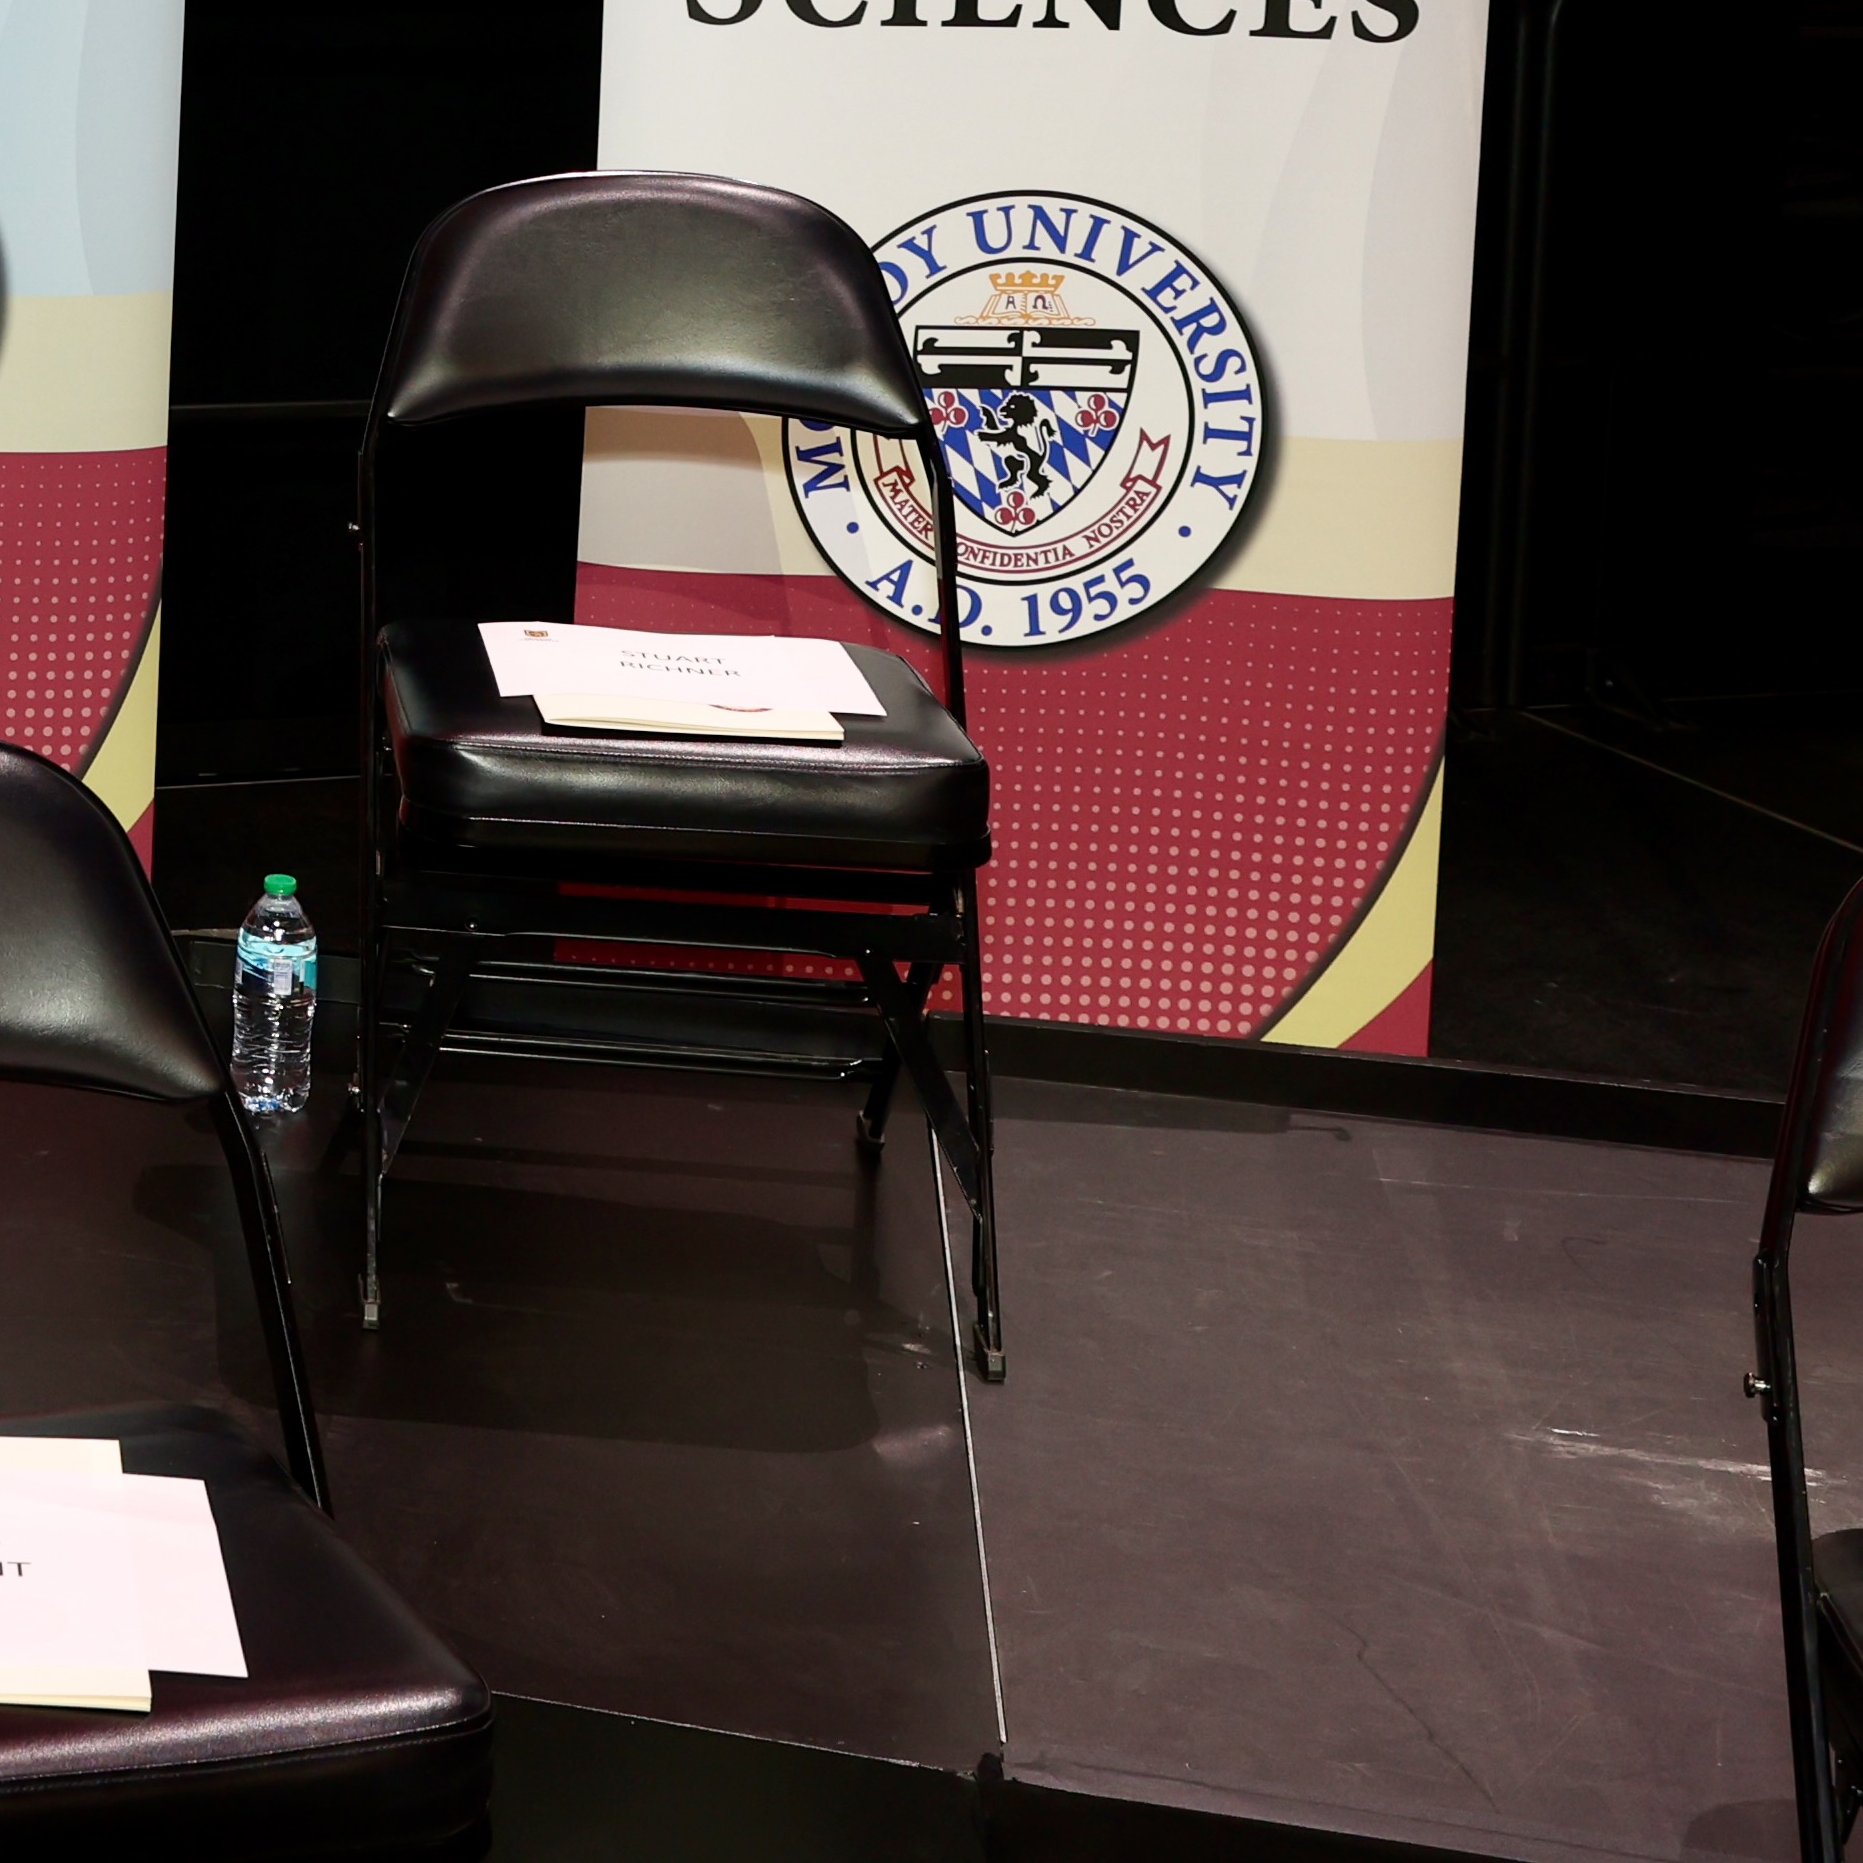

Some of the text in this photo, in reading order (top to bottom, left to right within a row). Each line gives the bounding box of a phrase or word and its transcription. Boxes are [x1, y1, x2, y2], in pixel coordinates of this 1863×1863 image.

[966, 203, 1257, 511] UNIVERSITY
[882, 479, 1151, 568] MATER ONFIDENTIA NOSTRA
[1020, 558, 1151, 638] 1955
[620, 661, 741, 677] RICHNER
[621, 650, 727, 664] STUART
